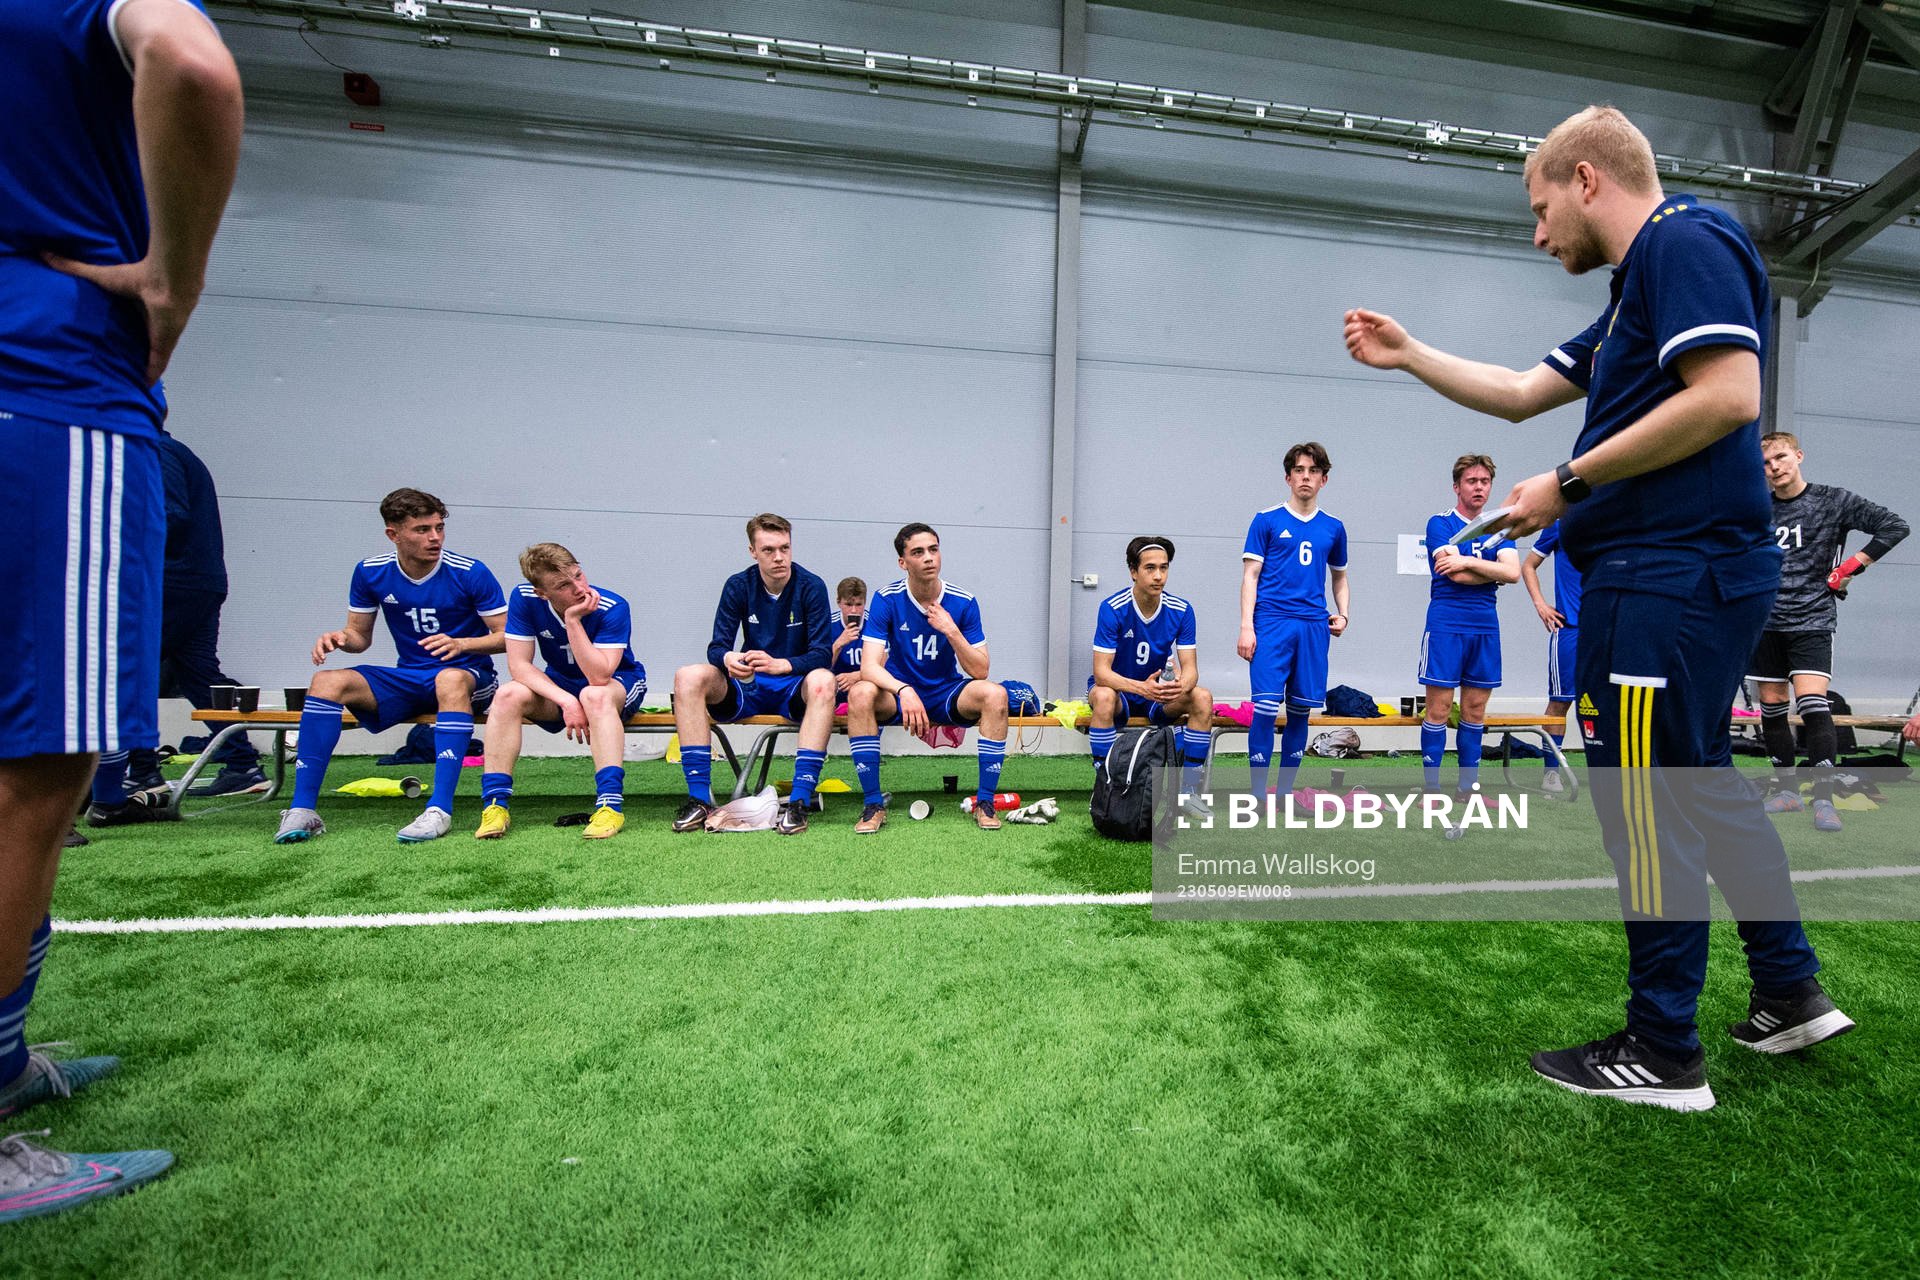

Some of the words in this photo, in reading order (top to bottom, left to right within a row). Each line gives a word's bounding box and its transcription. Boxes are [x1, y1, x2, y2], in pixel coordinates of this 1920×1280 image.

[1775, 524, 1802, 549] 21
[1299, 540, 1313, 566] 6
[1472, 542, 1482, 559] 5
[404, 607, 440, 634] 15
[846, 647, 862, 666] 10
[912, 634, 939, 660] 14
[1135, 641, 1150, 665] 9
